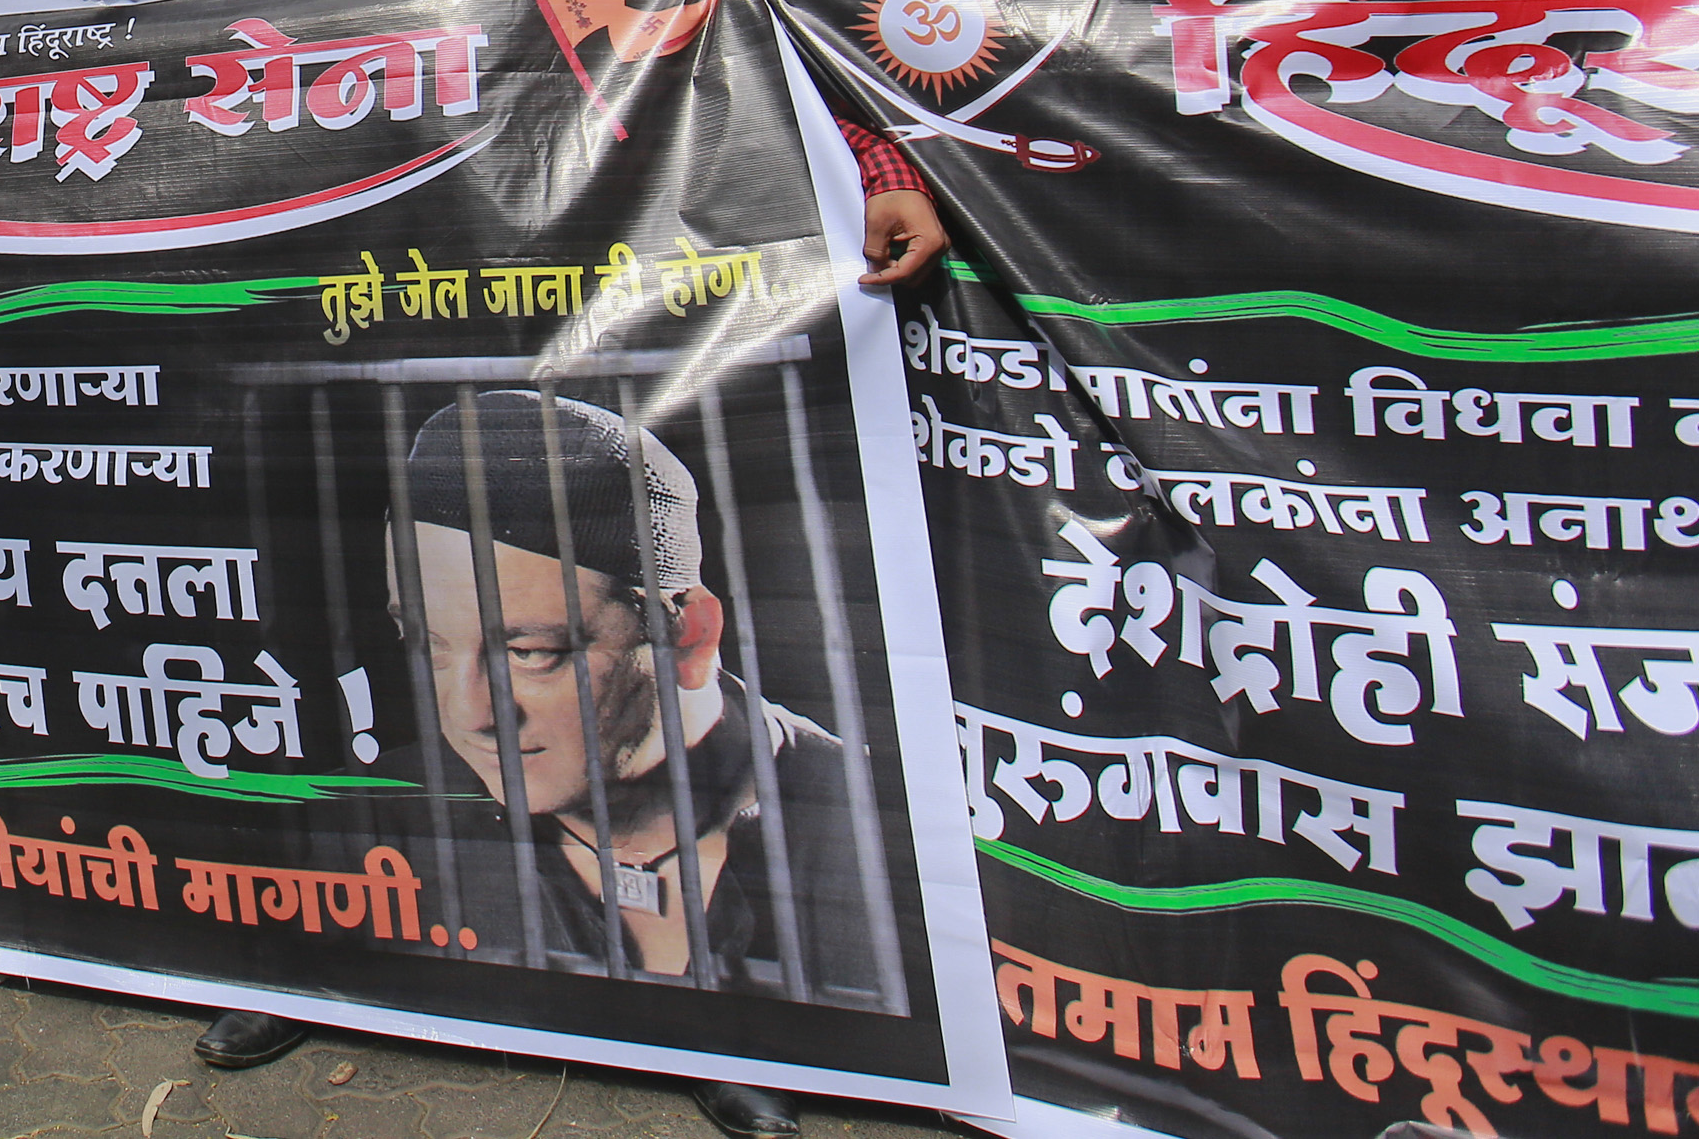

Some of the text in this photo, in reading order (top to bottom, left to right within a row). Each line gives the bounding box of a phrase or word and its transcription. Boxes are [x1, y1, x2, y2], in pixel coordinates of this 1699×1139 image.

[16, 22, 118, 61] हिंदूराष्ट्र
[184, 18, 489, 137] सेना
[318, 251, 384, 346] तुझे
[397, 248, 469, 320] जेल
[480, 265, 583, 317] जाना
[911, 394, 1079, 490] शेकडो
[1344, 366, 1640, 448] विधवा
[56, 539, 260, 630] दत्तला
[1042, 518, 1464, 747] देशद्रोही
[73, 642, 303, 779] पाहिजे
[991, 937, 1262, 1080] तमाम
